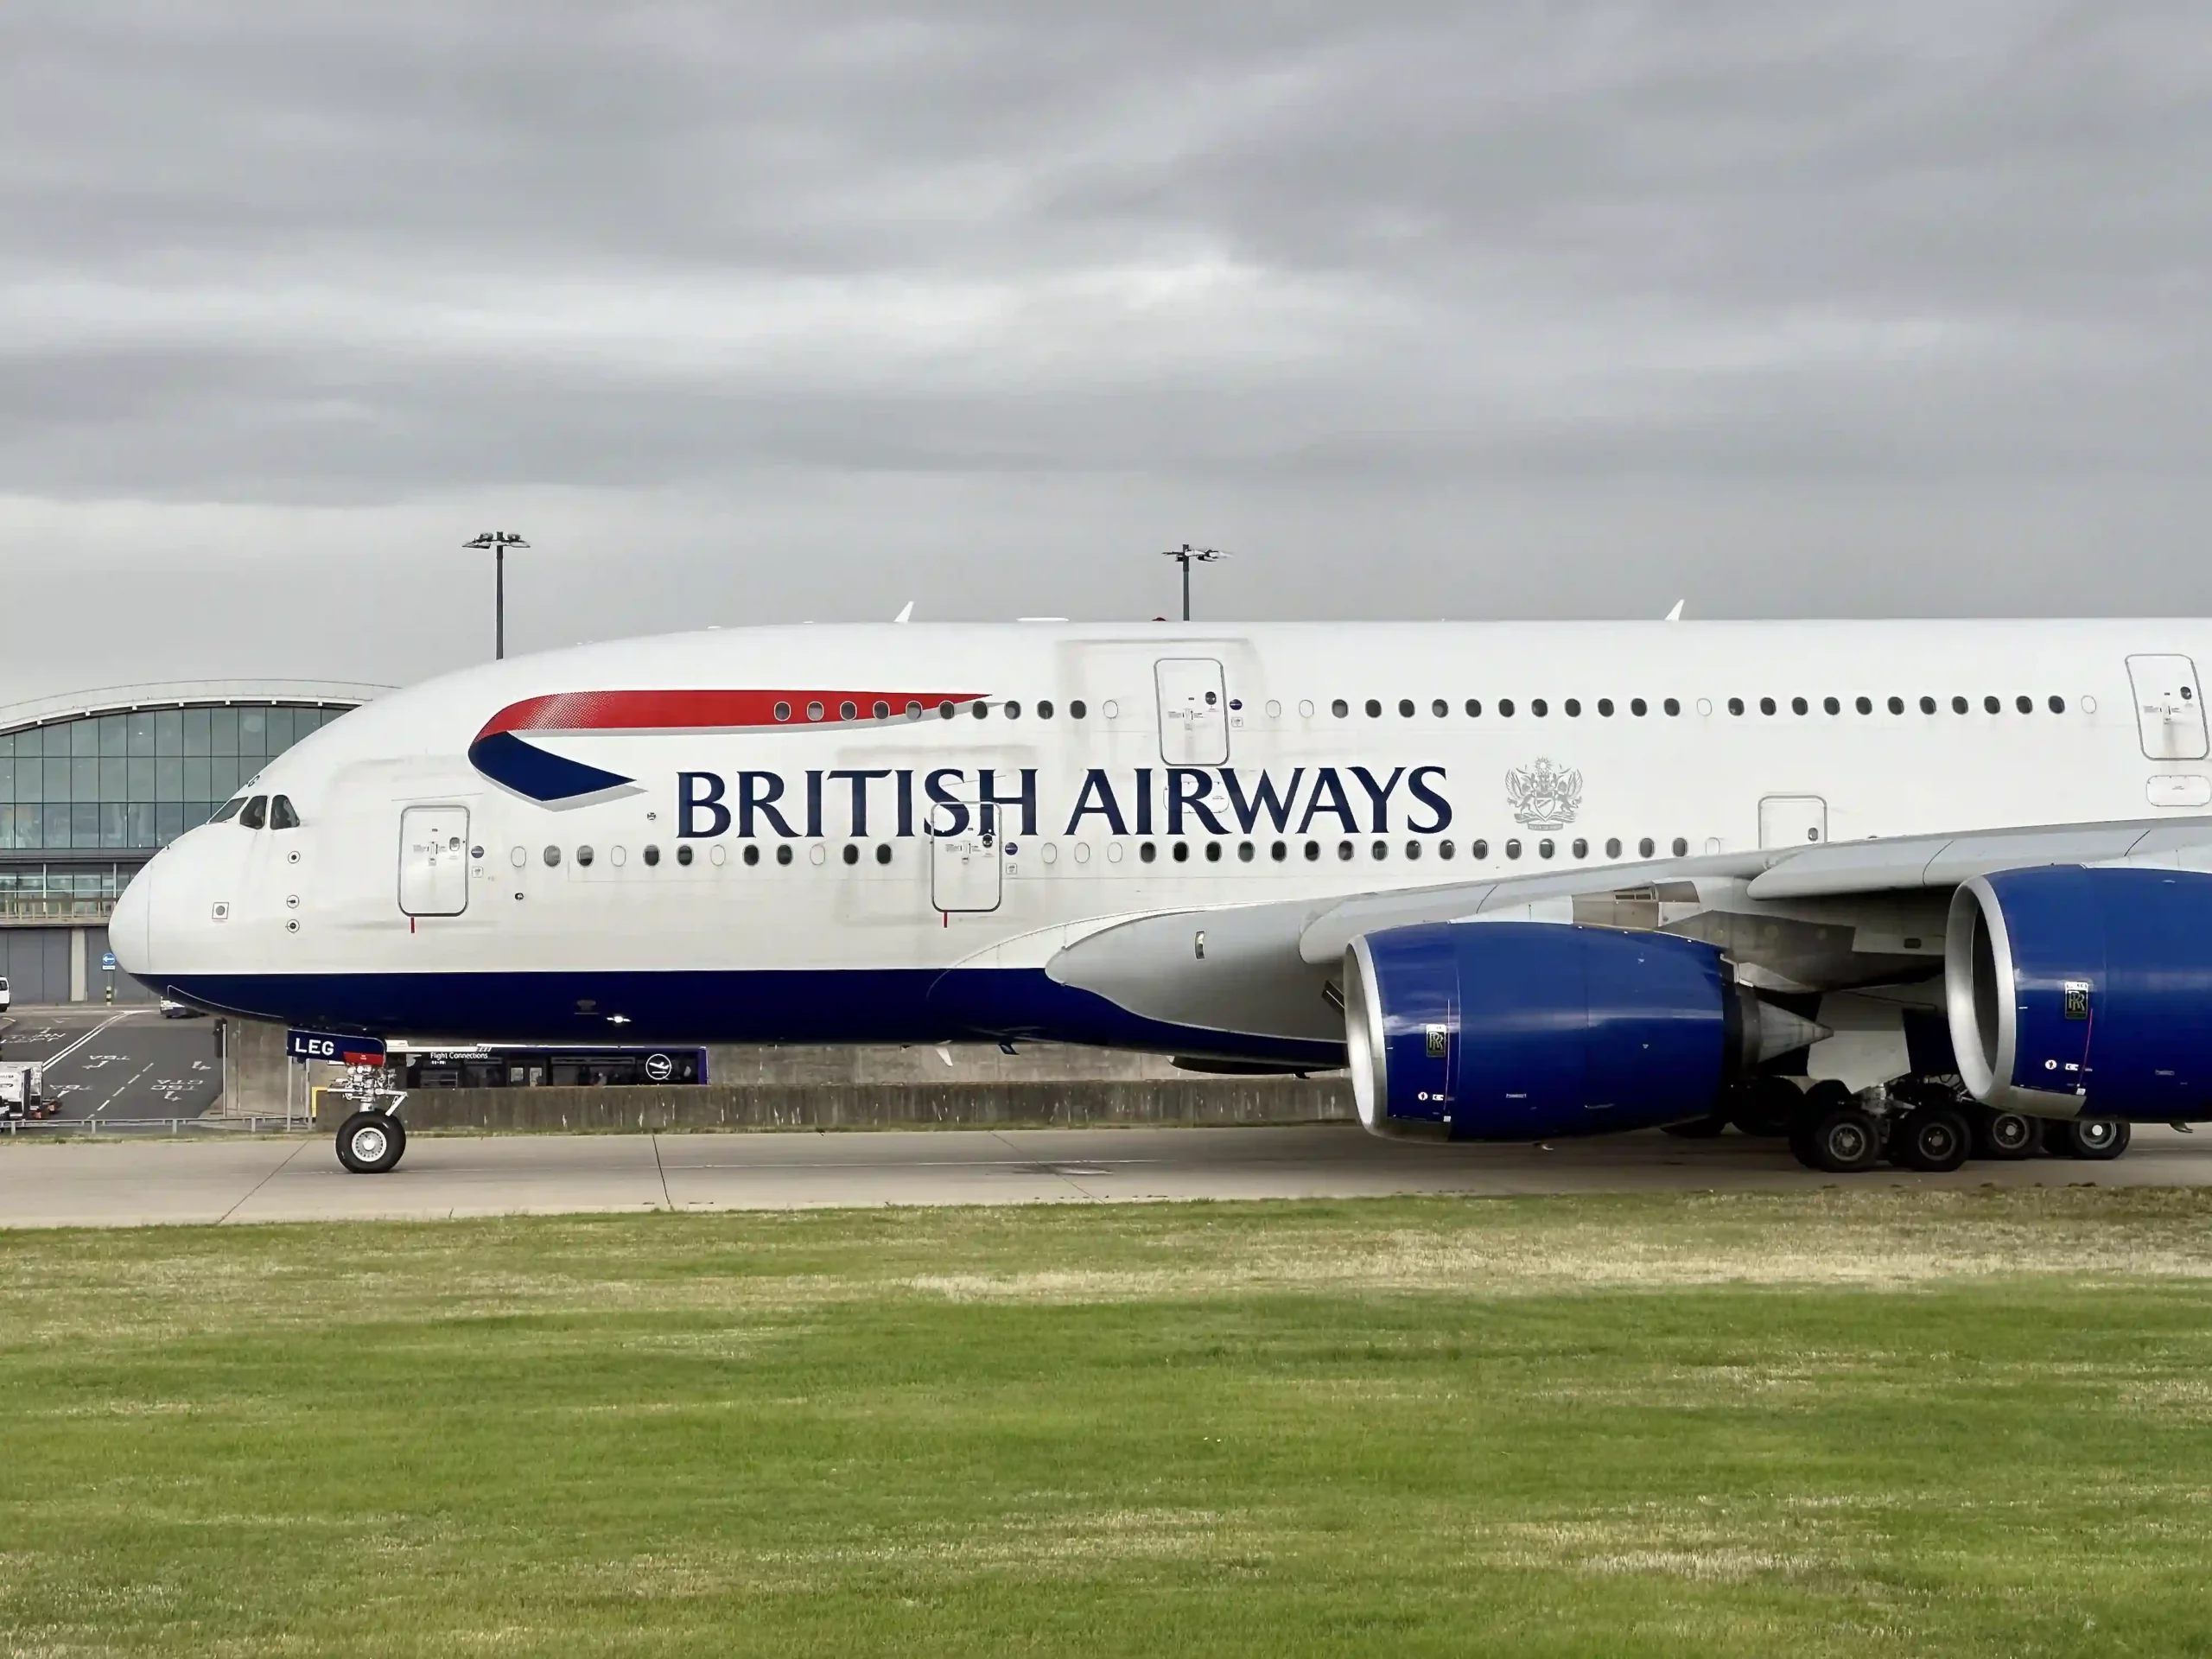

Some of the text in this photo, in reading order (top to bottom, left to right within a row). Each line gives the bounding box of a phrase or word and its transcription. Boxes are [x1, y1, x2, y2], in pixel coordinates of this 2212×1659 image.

[676, 766, 1452, 838] BRITISH AIRWAYS
[295, 1038, 334, 1055] LEG
[430, 1052, 448, 1060] Flight
